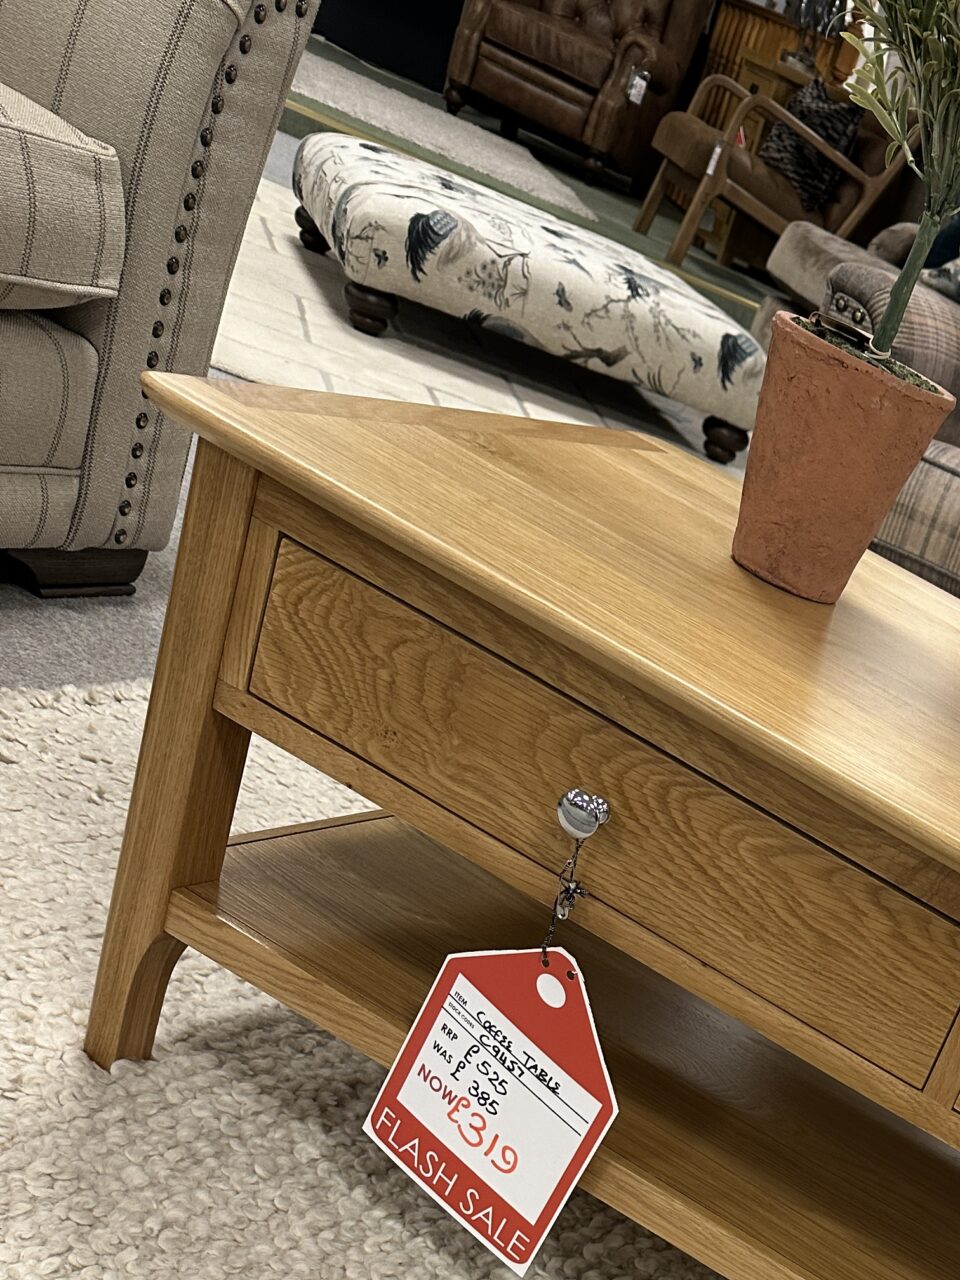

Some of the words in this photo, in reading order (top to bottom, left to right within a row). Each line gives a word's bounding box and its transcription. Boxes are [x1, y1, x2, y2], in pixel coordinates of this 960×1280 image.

[432, 1040, 454, 1065] WAS
[468, 1080, 500, 1116] 385
[441, 1023, 459, 1041] RRP
[476, 1060, 509, 1096] 525
[454, 991, 468, 1007] ITEM
[476, 1011, 513, 1053] COFFEE
[522, 1050, 561, 1095] TABLE
[417, 1063, 458, 1106] NOW
[376, 1106, 459, 1197] FLASH
[459, 1188, 531, 1261] SALE
